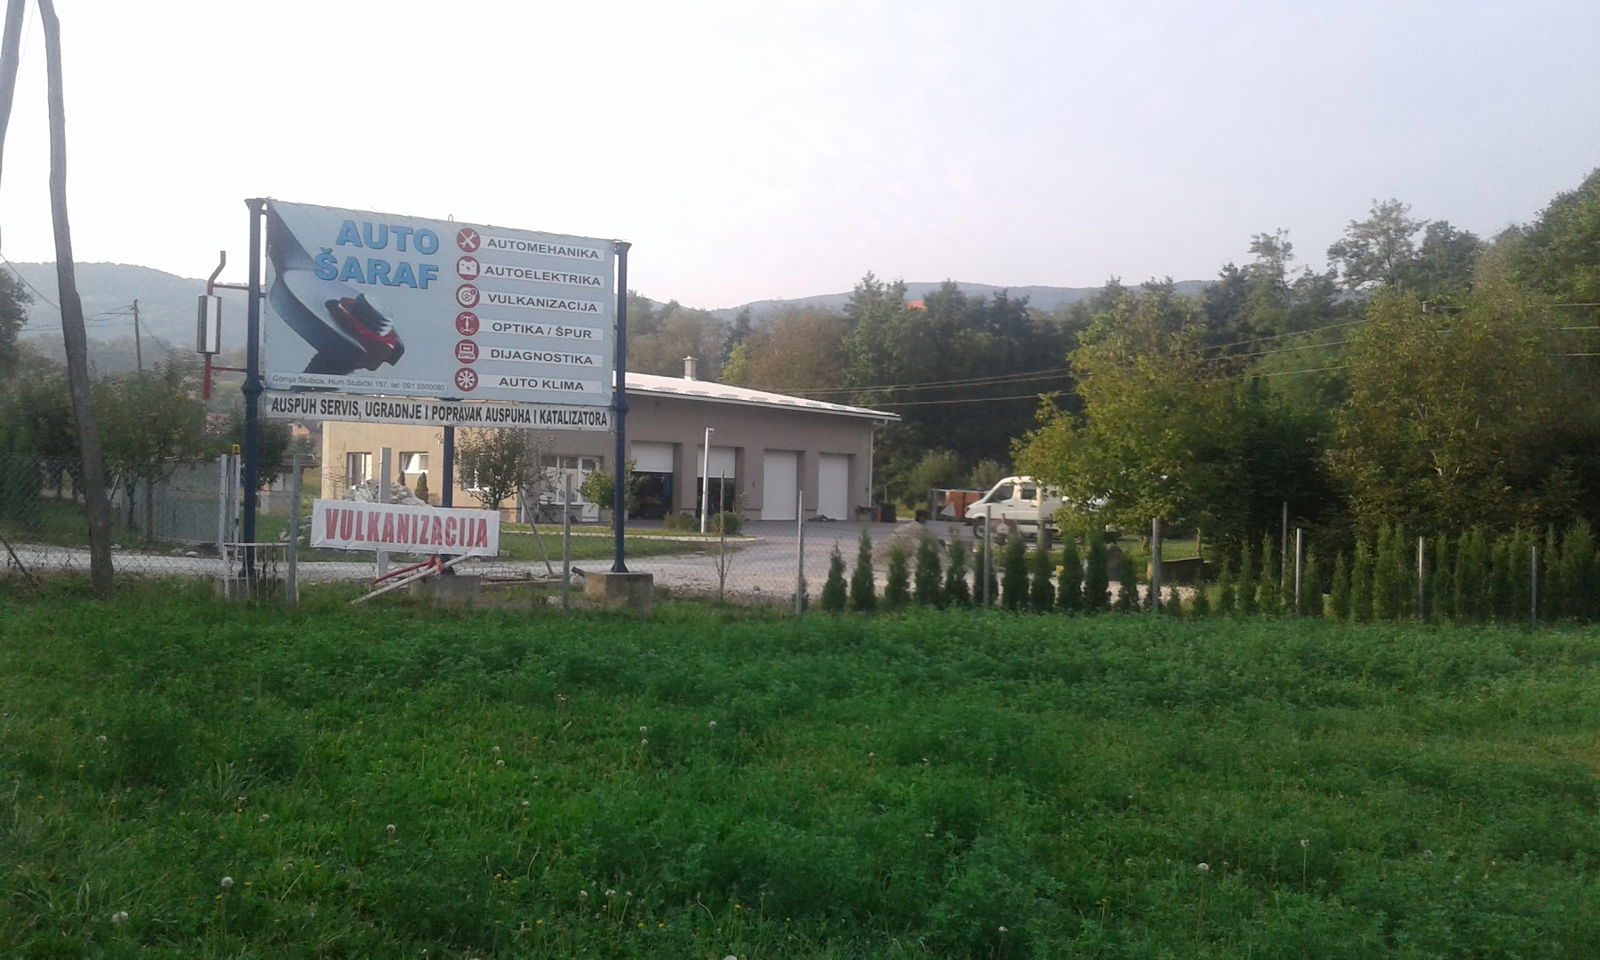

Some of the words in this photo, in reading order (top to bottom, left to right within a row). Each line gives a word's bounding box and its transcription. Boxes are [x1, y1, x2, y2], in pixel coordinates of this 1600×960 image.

[336, 220, 439, 255] AUTO
[487, 238, 599, 259] AUTOMEHANIKA
[313, 247, 439, 289] ŠARAF
[485, 266, 601, 286] AUTOELEKTRIKA
[487, 293, 598, 312] VULKANIZACIJA
[492, 322, 544, 335] OPTIKA
[547, 327, 552, 336] /
[555, 325, 592, 339] ŠPUR
[490, 348, 593, 365] DIJAGNOSTIKA
[499, 377, 538, 388] AUTO
[542, 380, 584, 391] KLIMA
[271, 397, 317, 414] AUSPUH
[320, 399, 362, 419] SERVIS,
[365, 401, 422, 419] UGRADNJE
[425, 405, 429, 420] I
[432, 405, 482, 422] POPRAVAK
[485, 407, 531, 424] AUSPUHA
[533, 409, 537, 424] I
[539, 409, 608, 426] KATALIZATORA
[325, 508, 488, 548] VULKANIZACIJA
